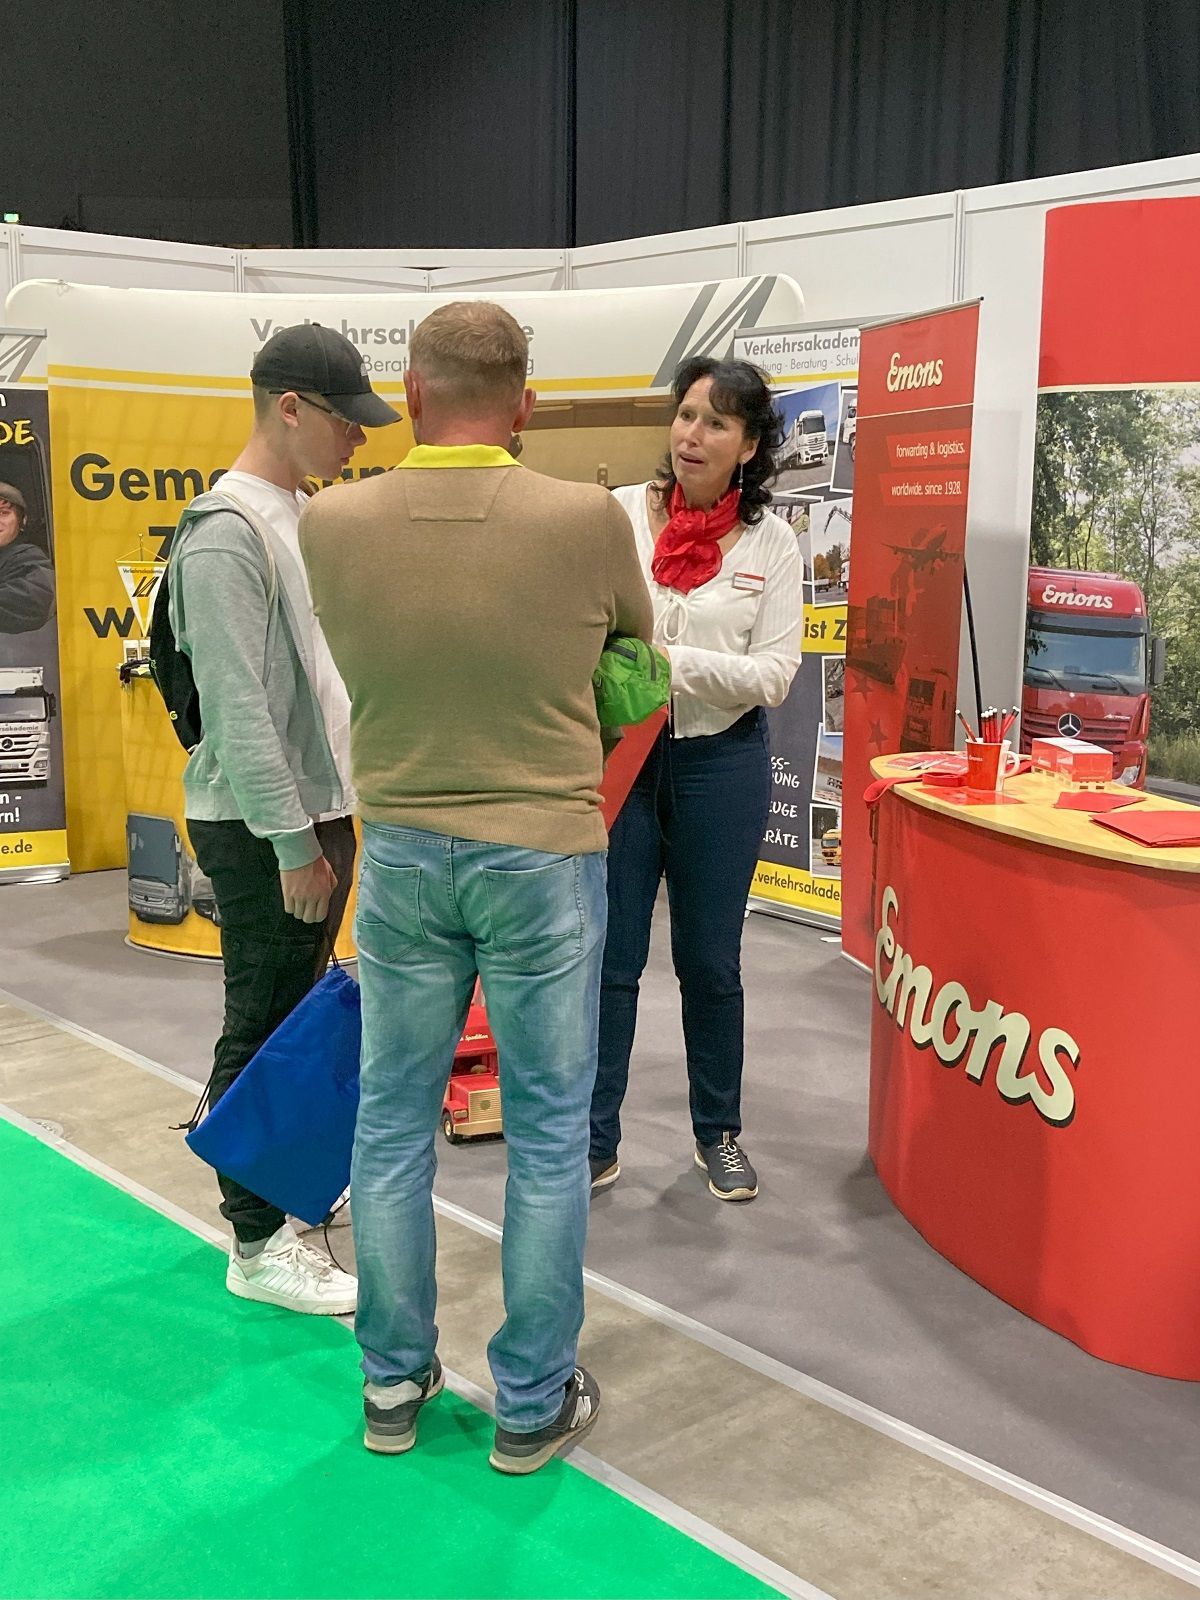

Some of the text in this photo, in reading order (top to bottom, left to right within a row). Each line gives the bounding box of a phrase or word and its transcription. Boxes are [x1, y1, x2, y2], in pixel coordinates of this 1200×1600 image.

[790, 356, 829, 371] Beratung
[887, 352, 944, 393] Emons
[896, 442, 929, 460] forwarding
[929, 441, 936, 456] &
[891, 480, 962, 496] worldwide. since 1928.
[1042, 584, 1113, 609] Emons
[804, 616, 827, 639] ist
[772, 771, 800, 788] UNG
[763, 828, 799, 849] RÄTE
[754, 871, 841, 902] .verkehrsakade
[875, 885, 1081, 1128] Emons
